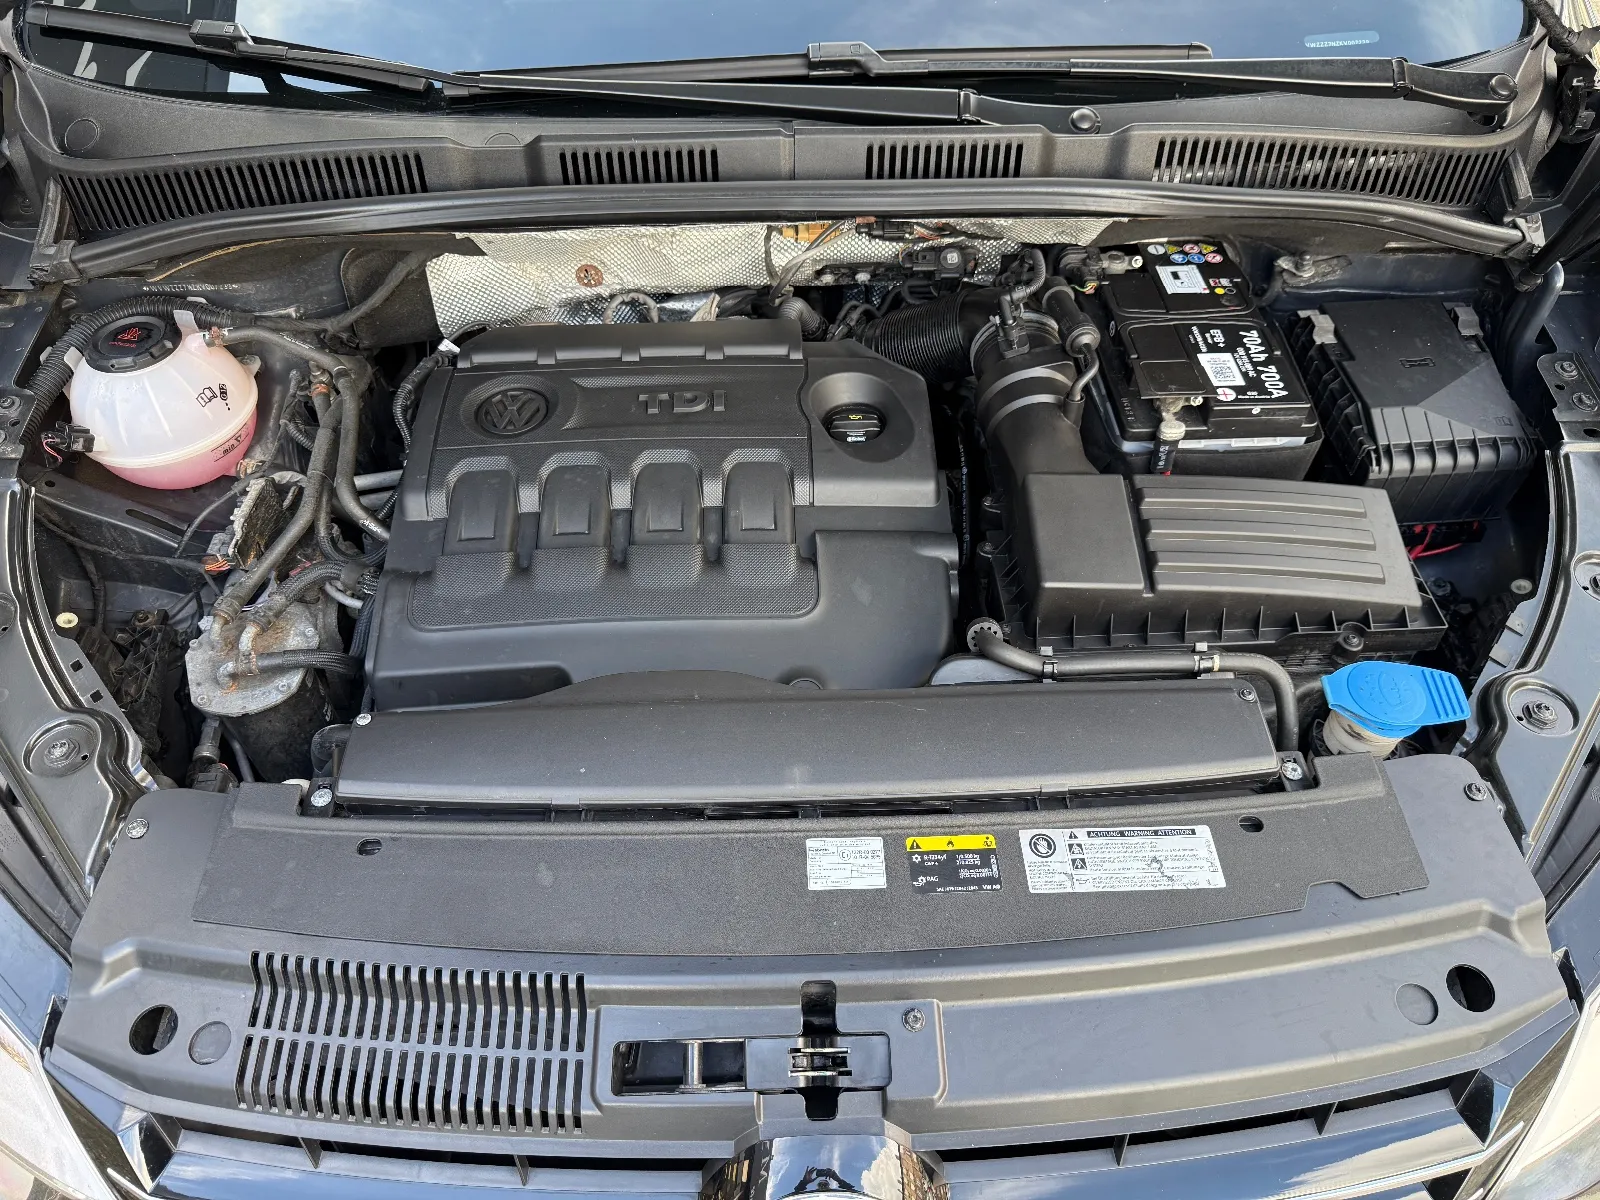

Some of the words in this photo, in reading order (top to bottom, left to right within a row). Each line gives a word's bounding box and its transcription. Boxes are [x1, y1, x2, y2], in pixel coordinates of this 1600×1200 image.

[1239, 330, 1269, 361] 70Ah
[1257, 365, 1288, 398] 700A
[638, 390, 726, 414] TDI
